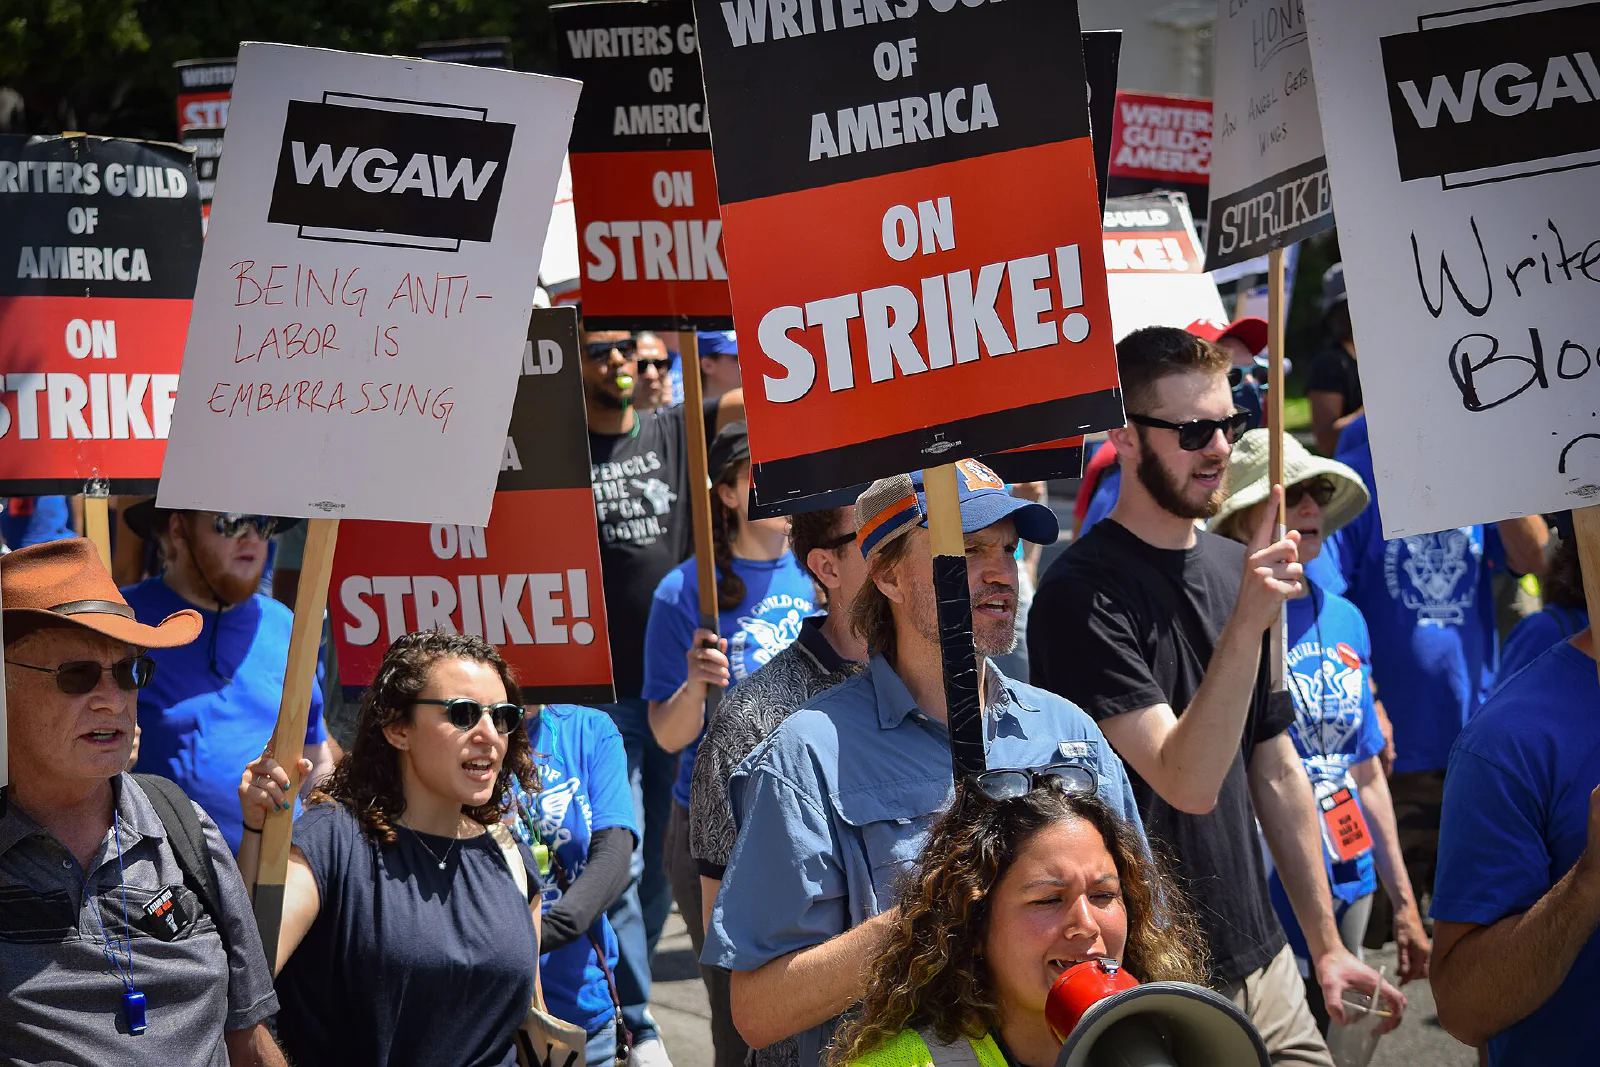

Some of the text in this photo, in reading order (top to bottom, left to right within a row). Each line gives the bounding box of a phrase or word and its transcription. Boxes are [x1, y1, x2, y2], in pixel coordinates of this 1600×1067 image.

[566, 25, 674, 59] WRITERS
[873, 37, 917, 81] OF
[649, 67, 674, 92] OF
[808, 83, 999, 162] AMERICA
[1120, 103, 1213, 133] WRITER
[1121, 127, 1196, 150] GUILD
[104, 163, 188, 199] GUILD
[291, 140, 499, 202] WGAW
[652, 170, 695, 208] ON
[67, 206, 99, 235] OF
[881, 196, 956, 262] ON
[1218, 168, 1334, 257] STRIKE
[17, 246, 152, 282] AMERICA
[229, 260, 493, 319] BEING ANTI-
[65, 318, 118, 360] ON
[234, 322, 400, 364] LABOR IS
[757, 243, 1091, 404] STRIKE!
[521, 339, 564, 377] LD
[1448, 327, 1600, 413] Blo
[206, 379, 455, 434] EMBARRASSING
[592, 478, 630, 502] THE
[429, 522, 488, 560] ON
[340, 568, 595, 646] STRIKE!
[750, 594, 793, 617] GUILD
